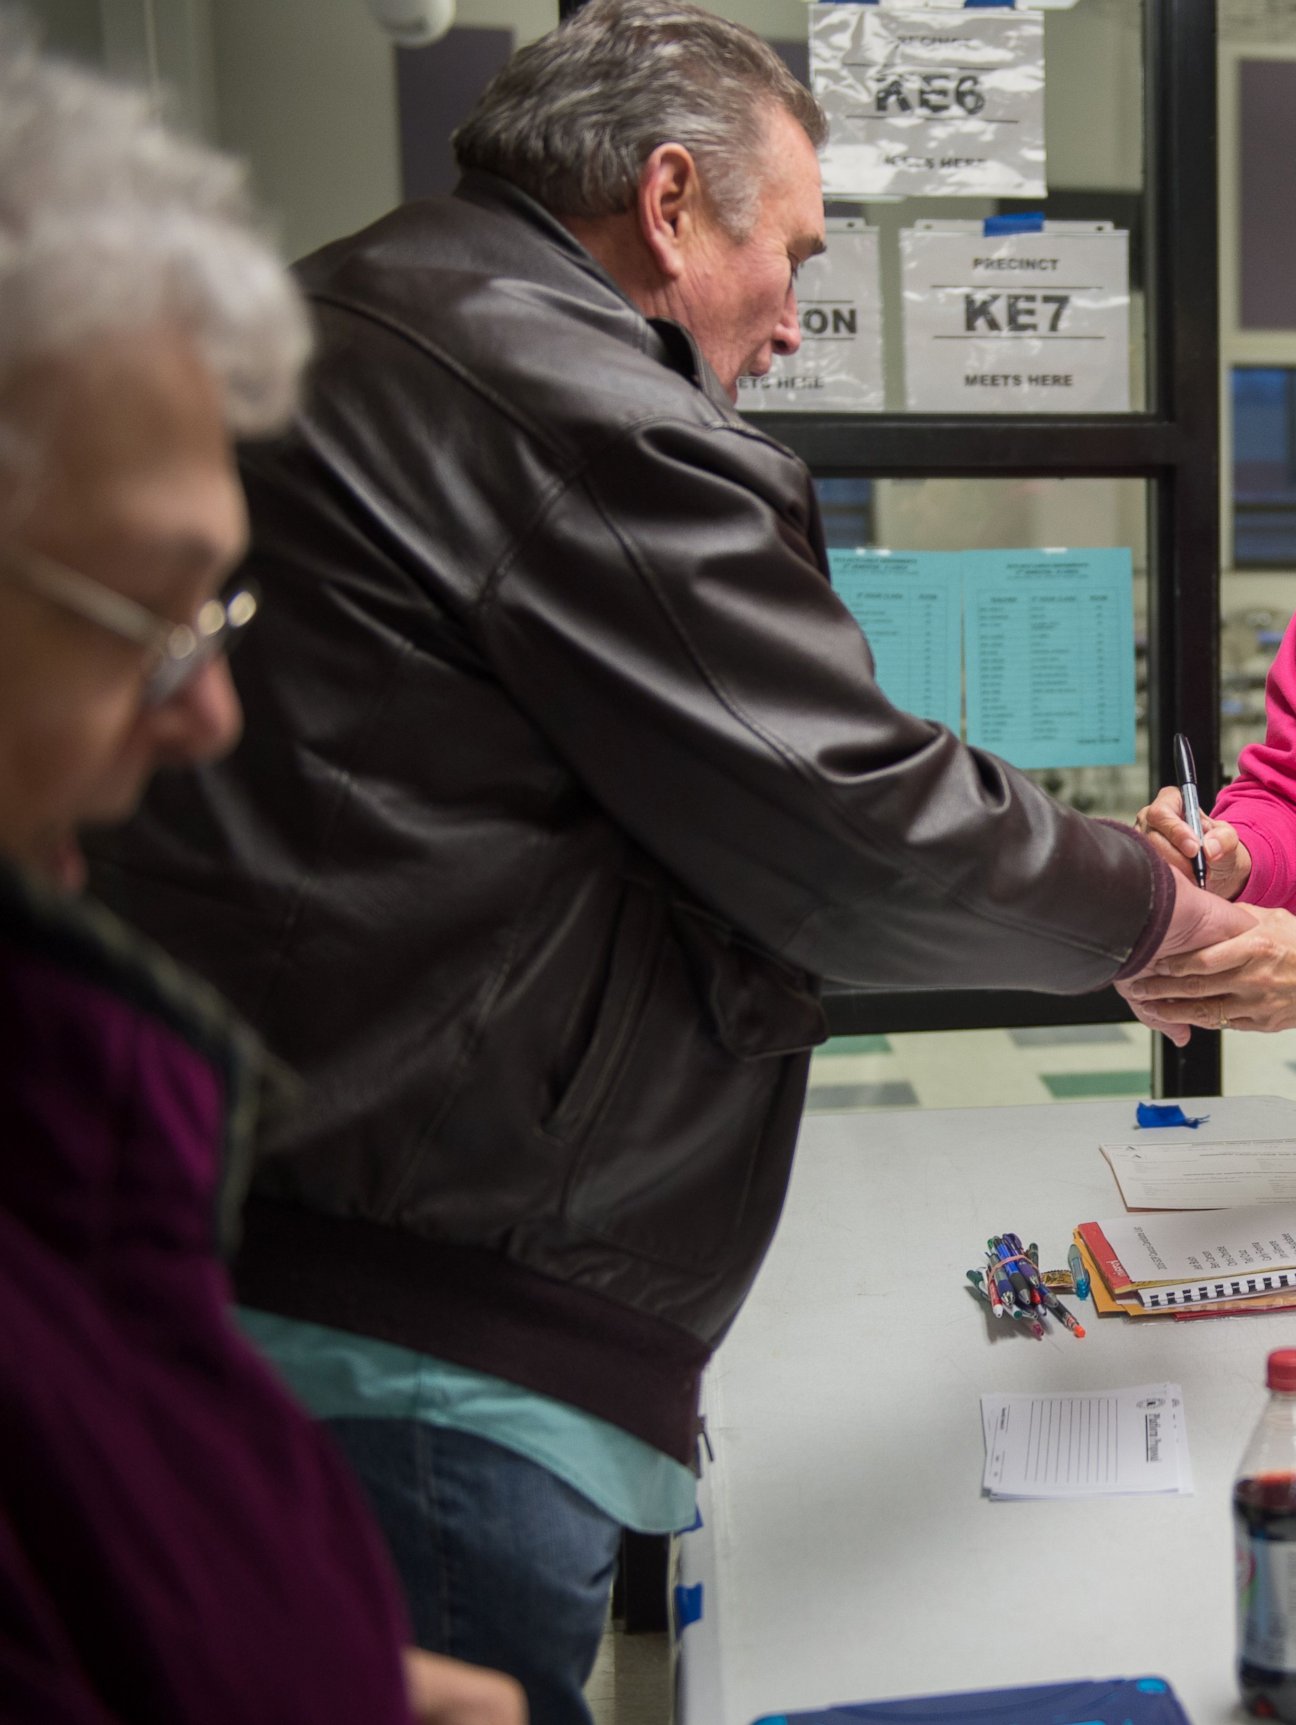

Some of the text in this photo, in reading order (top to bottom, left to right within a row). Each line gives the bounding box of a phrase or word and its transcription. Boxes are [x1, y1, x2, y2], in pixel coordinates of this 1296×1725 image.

[973, 258, 1059, 271] PRECINCT
[801, 308, 857, 334] ON
[964, 294, 1070, 333] KE7
[964, 374, 1074, 387] MEETS HERE
